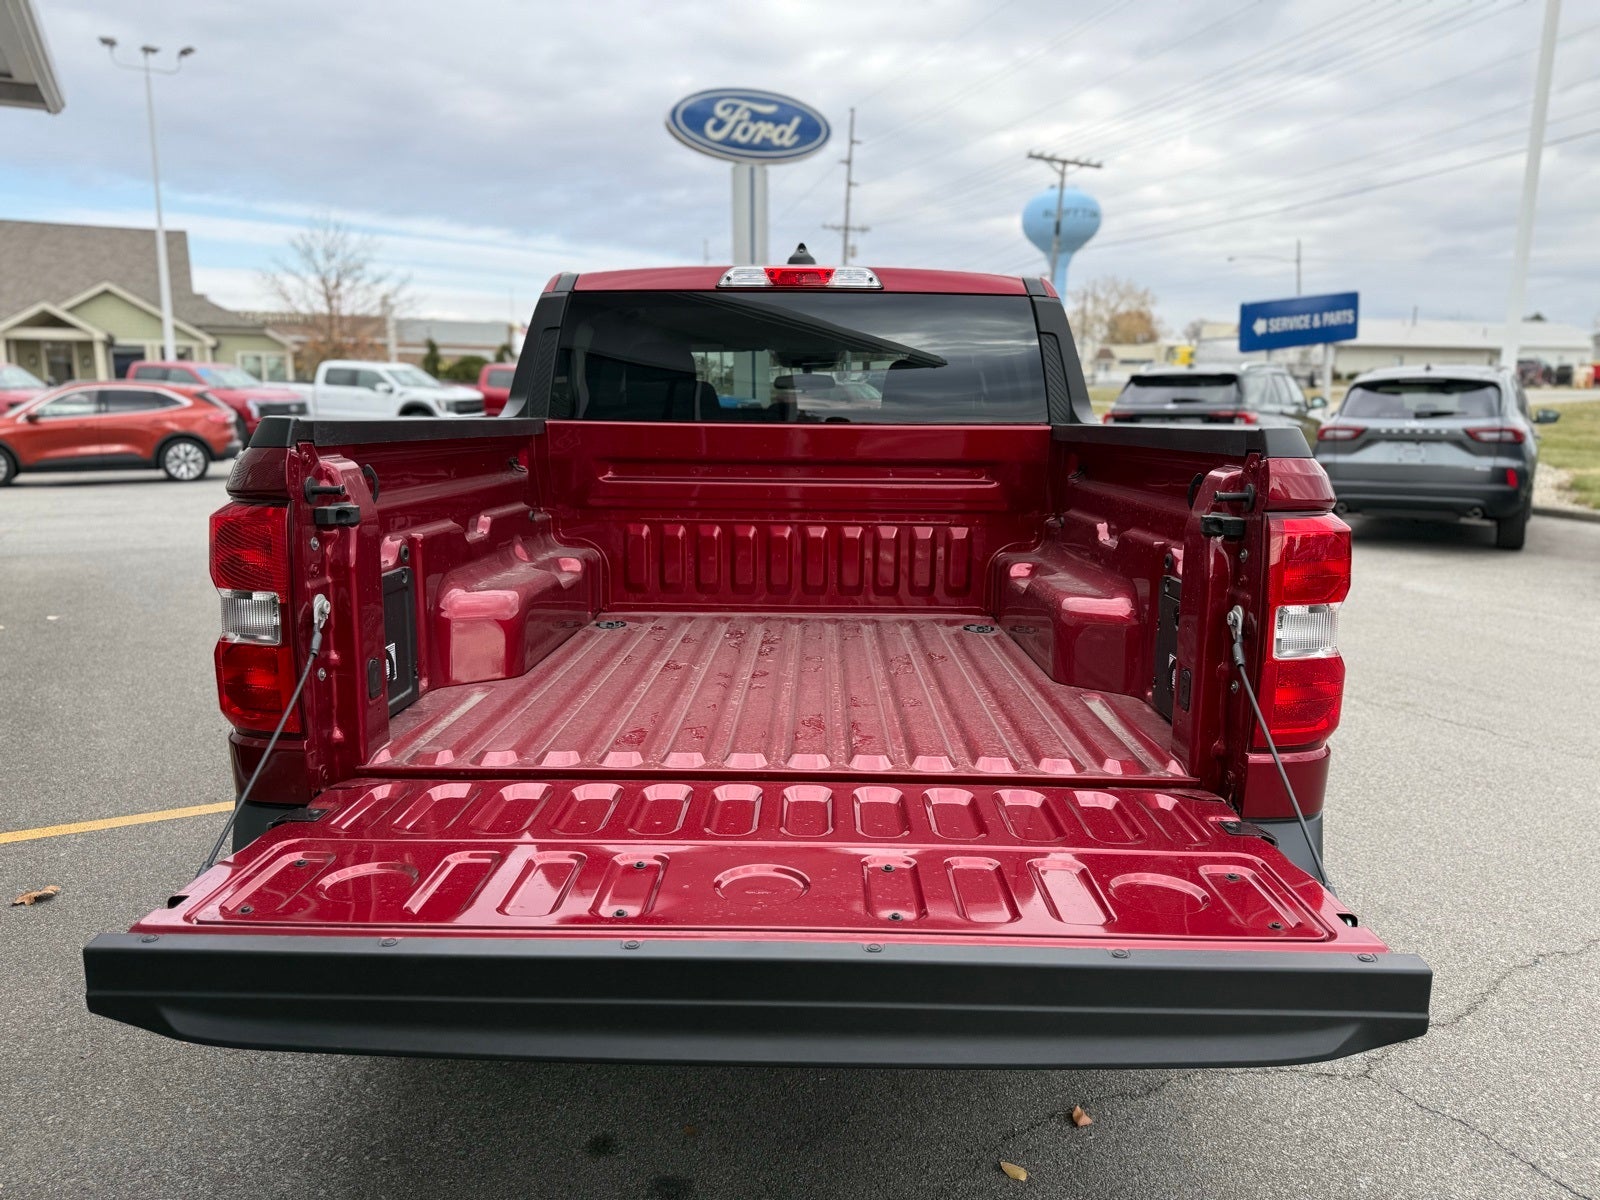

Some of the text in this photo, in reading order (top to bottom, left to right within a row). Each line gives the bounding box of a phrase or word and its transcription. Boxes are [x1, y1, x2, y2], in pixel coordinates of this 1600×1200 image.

[704, 98, 802, 147] Ford
[1268, 309, 1354, 333] SERVICE & PARTS
